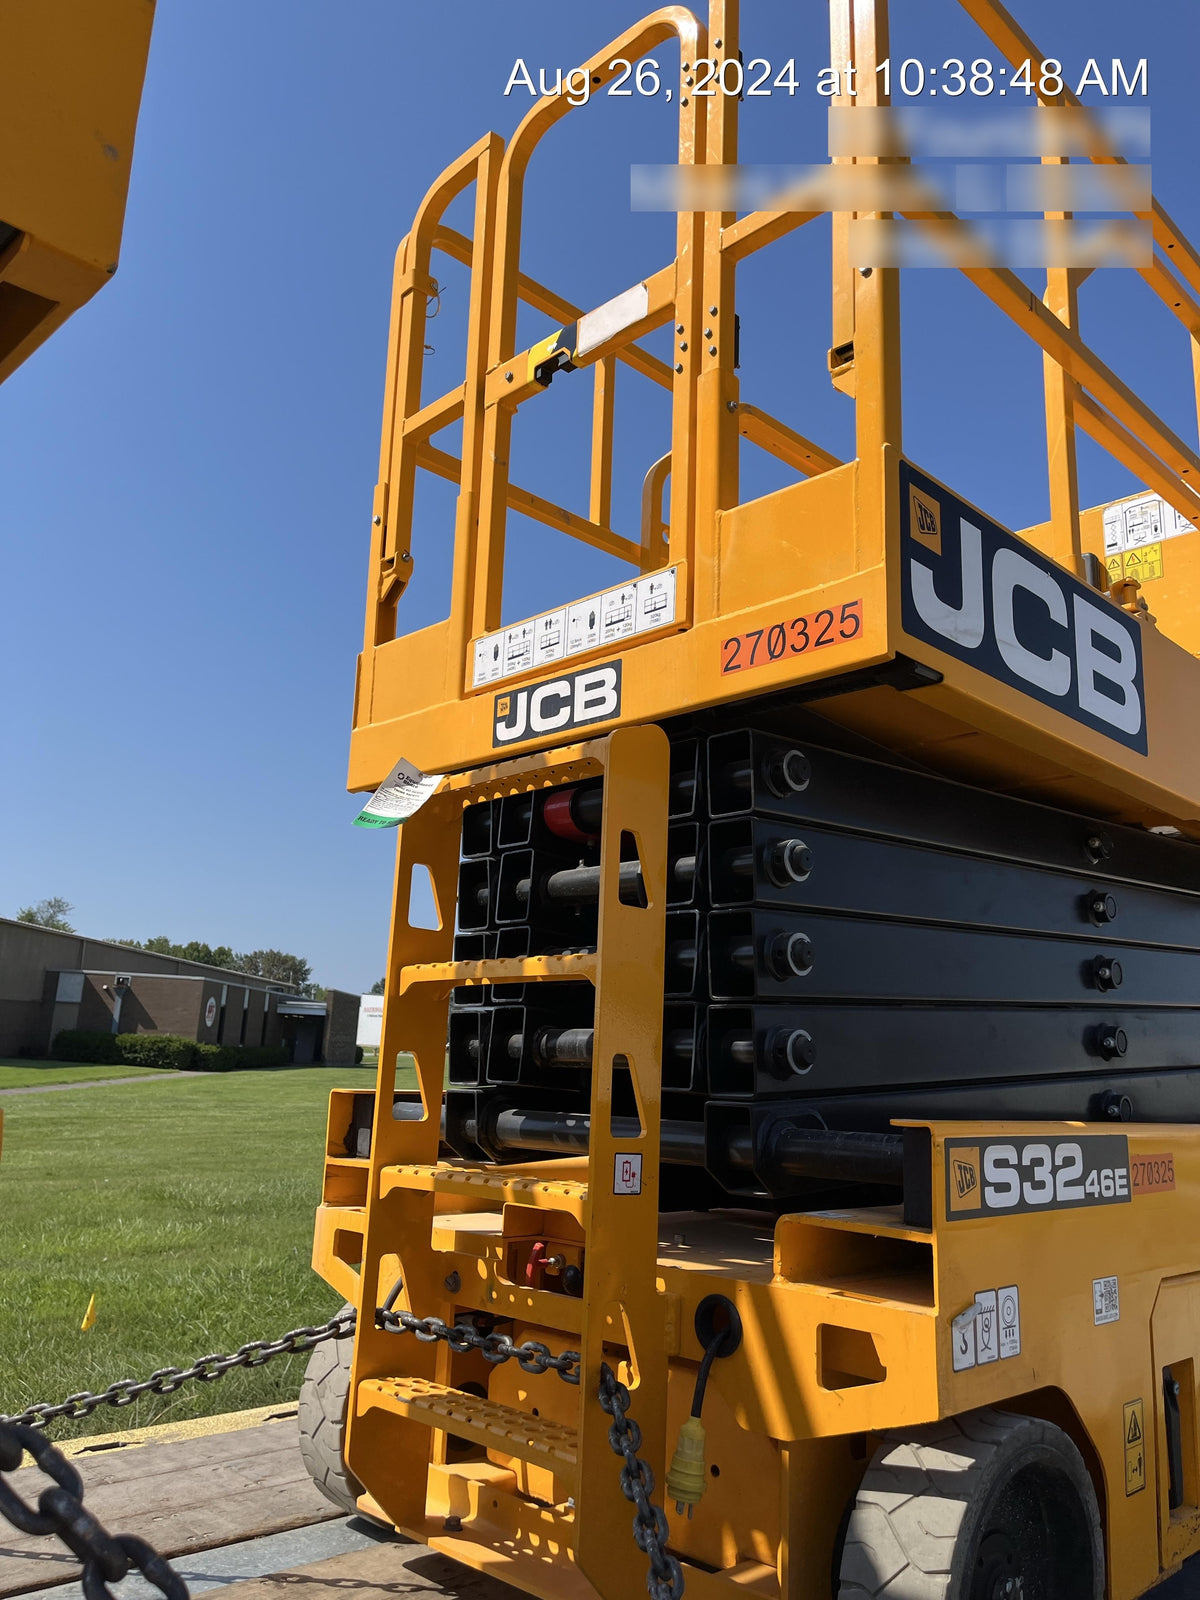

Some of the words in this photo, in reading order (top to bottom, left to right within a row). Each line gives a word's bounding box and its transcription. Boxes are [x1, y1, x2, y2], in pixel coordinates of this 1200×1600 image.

[917, 501, 937, 533] JCB
[722, 600, 862, 674] 270325
[910, 516, 1142, 736] JCB
[495, 667, 618, 742] JCB
[358, 815, 378, 825] READY
[957, 1163, 977, 1194] JCB
[1131, 1159, 1175, 1187] 270325
